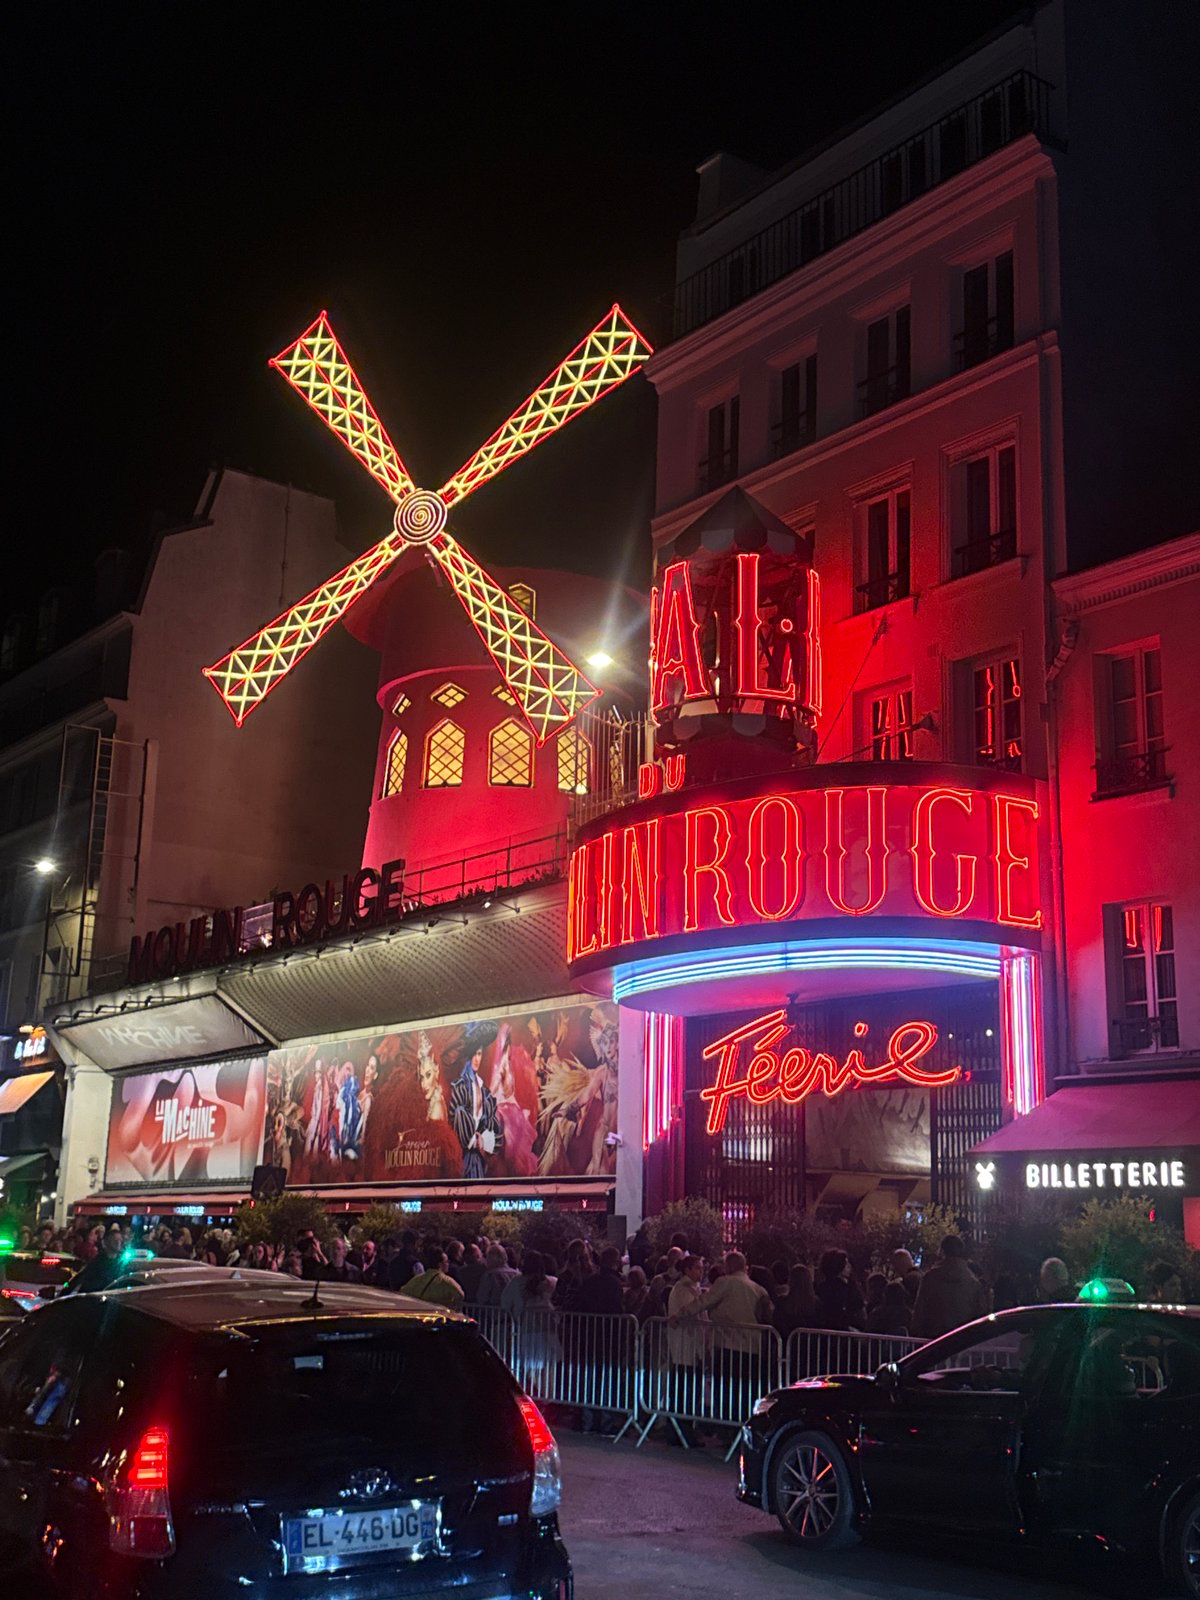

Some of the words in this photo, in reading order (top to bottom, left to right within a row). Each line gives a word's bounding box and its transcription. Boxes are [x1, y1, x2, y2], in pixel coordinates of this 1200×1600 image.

[638, 754, 685, 798] DU
[684, 786, 1042, 931] ROUGE
[128, 905, 243, 983] MOULIN
[272, 858, 406, 950] ROUGE
[701, 1008, 961, 1135] Féerie
[385, 1149, 413, 1169] MOULIN
[413, 1146, 441, 1168] ROUGE
[1026, 1161, 1184, 1188] BILLETTERIE
